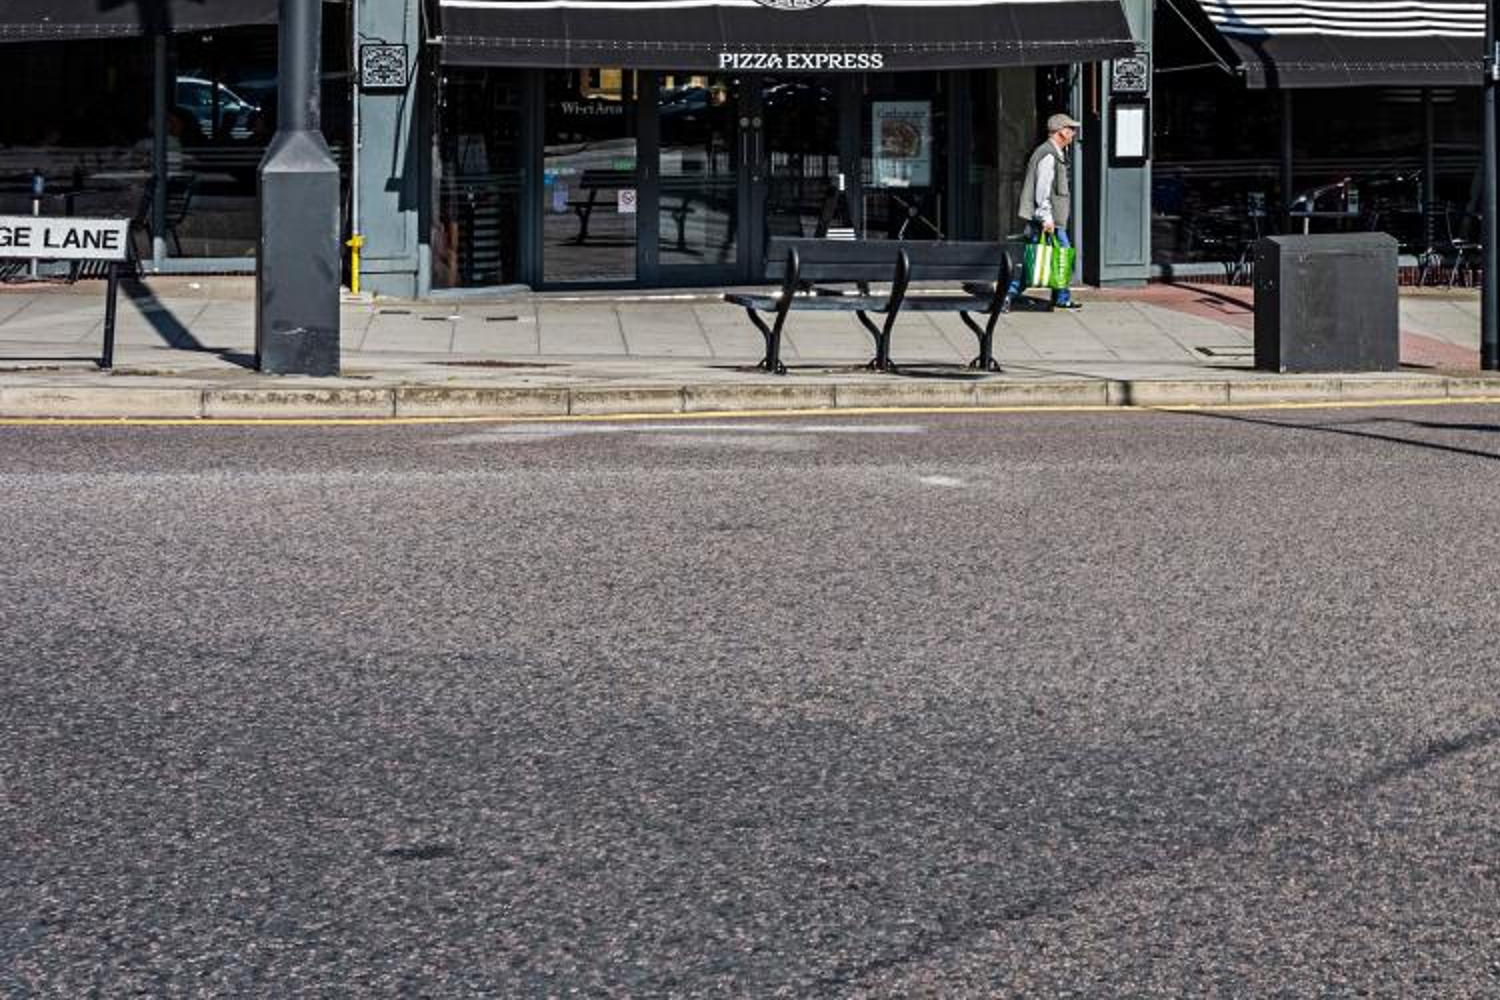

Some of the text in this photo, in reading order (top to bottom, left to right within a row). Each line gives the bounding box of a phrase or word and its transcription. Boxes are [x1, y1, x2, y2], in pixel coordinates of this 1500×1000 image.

[719, 53, 884, 69] PIZZA EXPRESS
[44, 227, 120, 249] LANE
